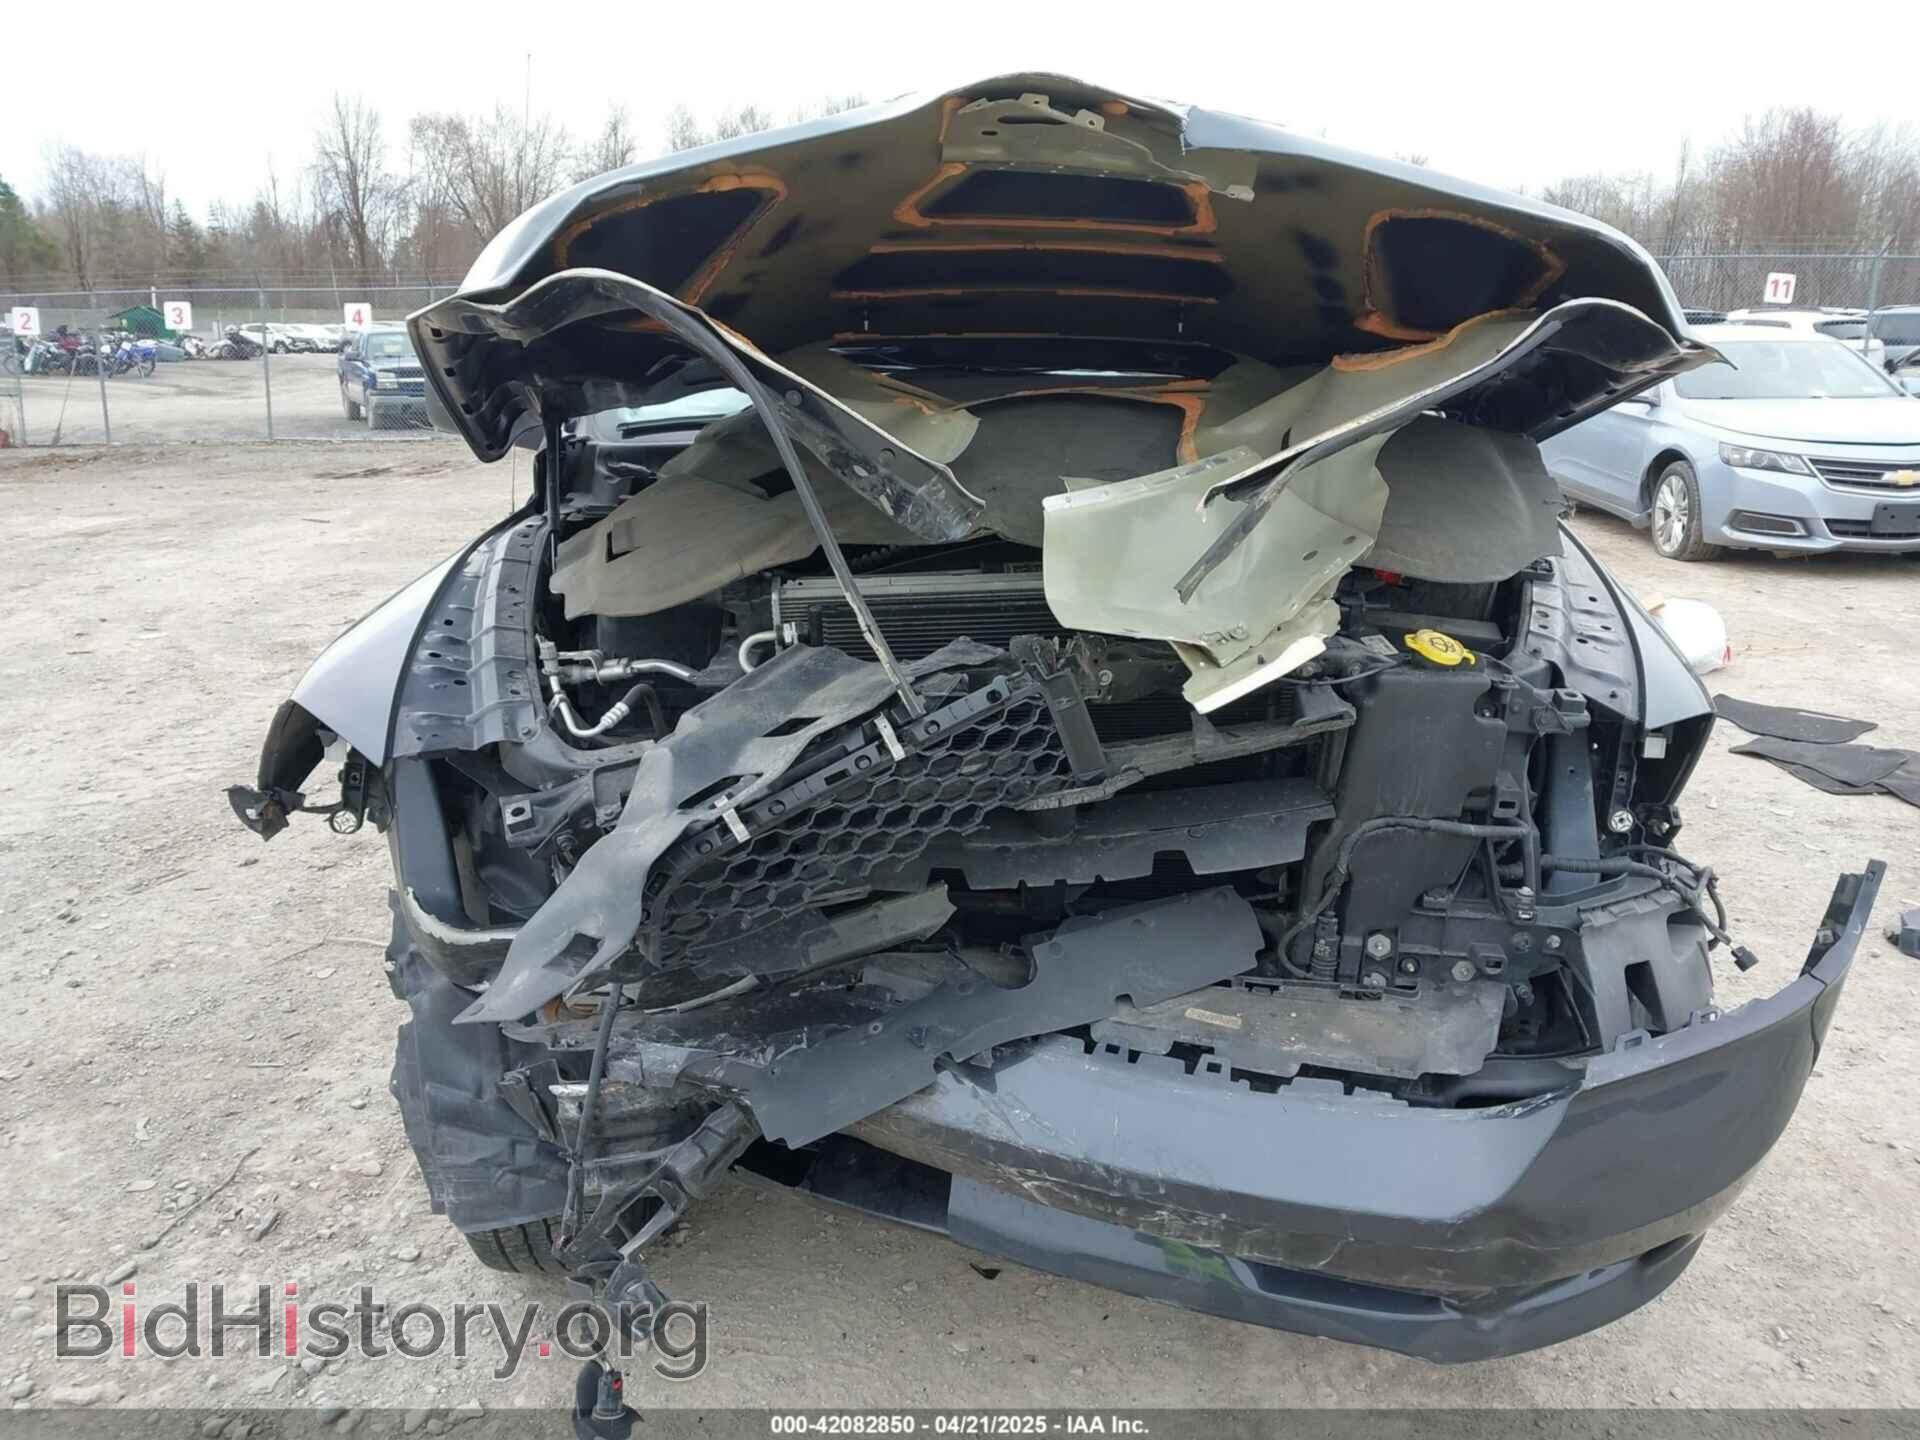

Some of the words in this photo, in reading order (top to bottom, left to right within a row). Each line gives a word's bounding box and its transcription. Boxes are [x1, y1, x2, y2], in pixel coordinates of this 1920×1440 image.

[1771, 279, 1791, 299] 11
[20, 312, 32, 330] 2
[171, 306, 184, 325] 3
[352, 308, 364, 327] 4
